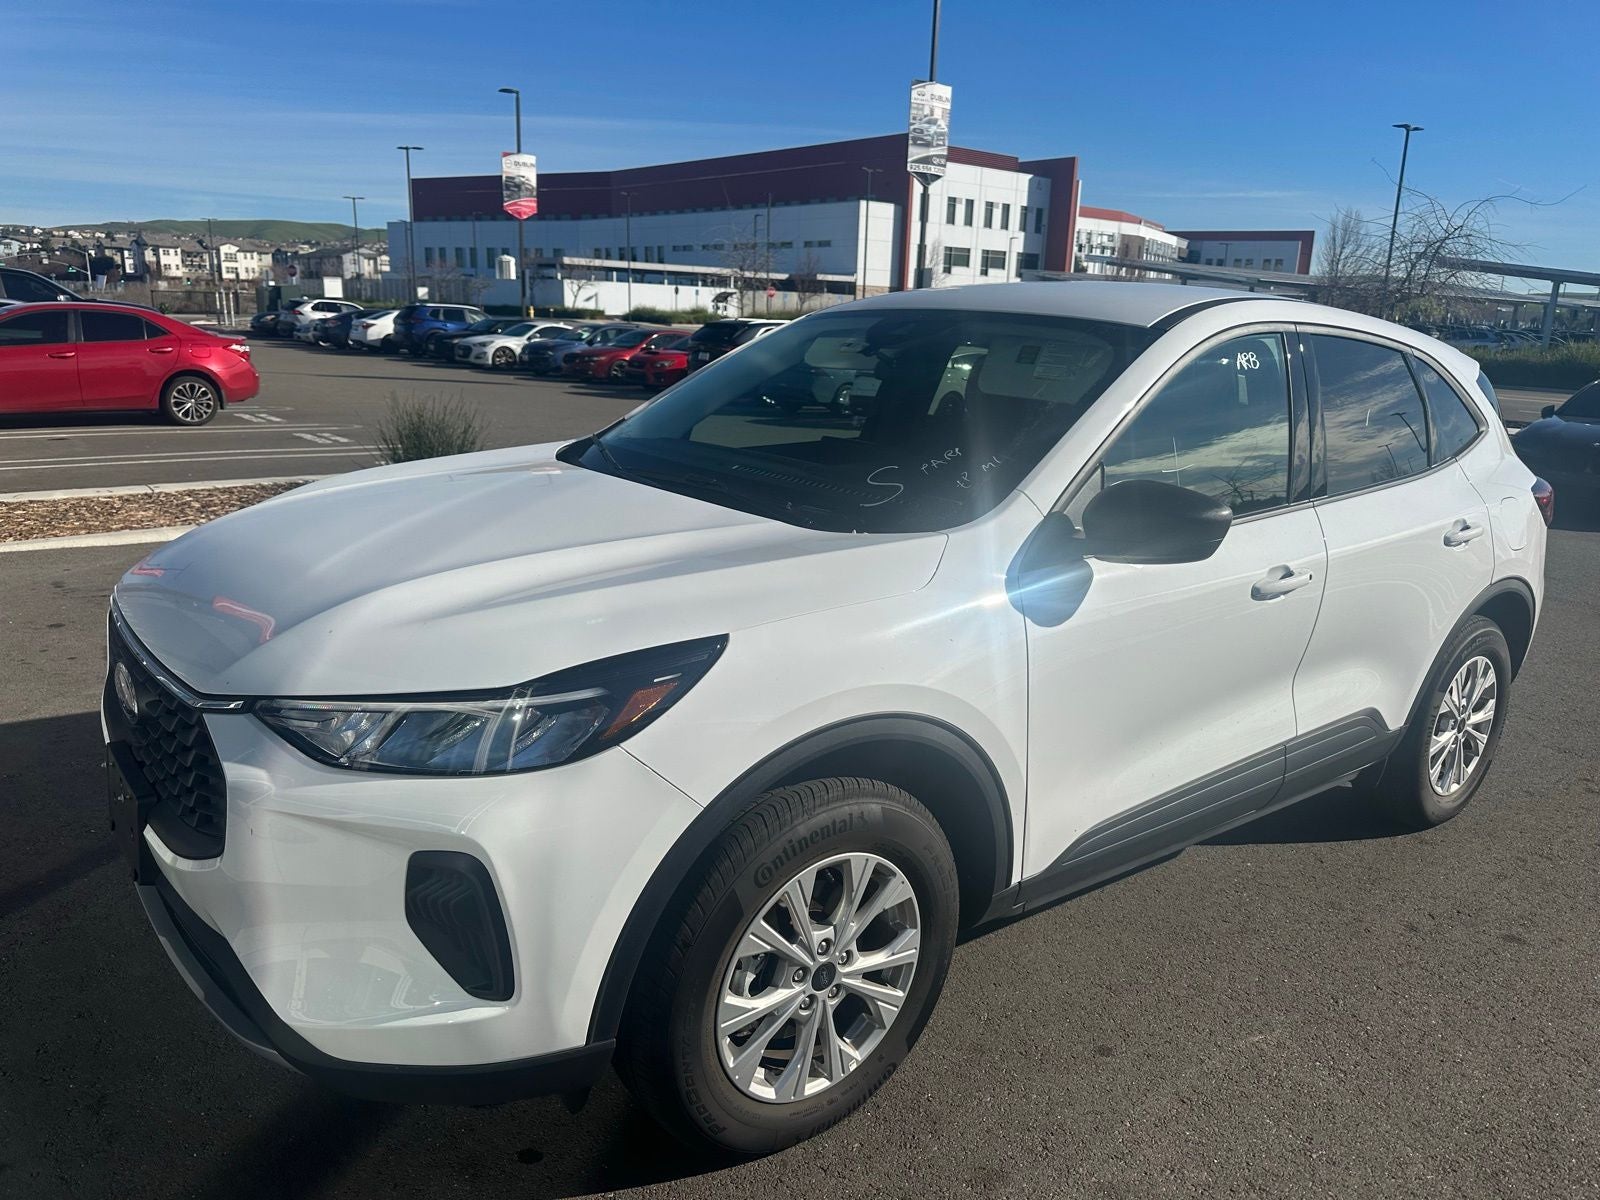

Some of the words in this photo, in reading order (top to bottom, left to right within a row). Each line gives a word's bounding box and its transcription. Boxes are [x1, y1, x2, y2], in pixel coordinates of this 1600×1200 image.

[930, 93, 951, 104] DUBLIN
[1236, 351, 1260, 371] ARB
[859, 465, 904, 507] S
[753, 812, 854, 888] Continental
